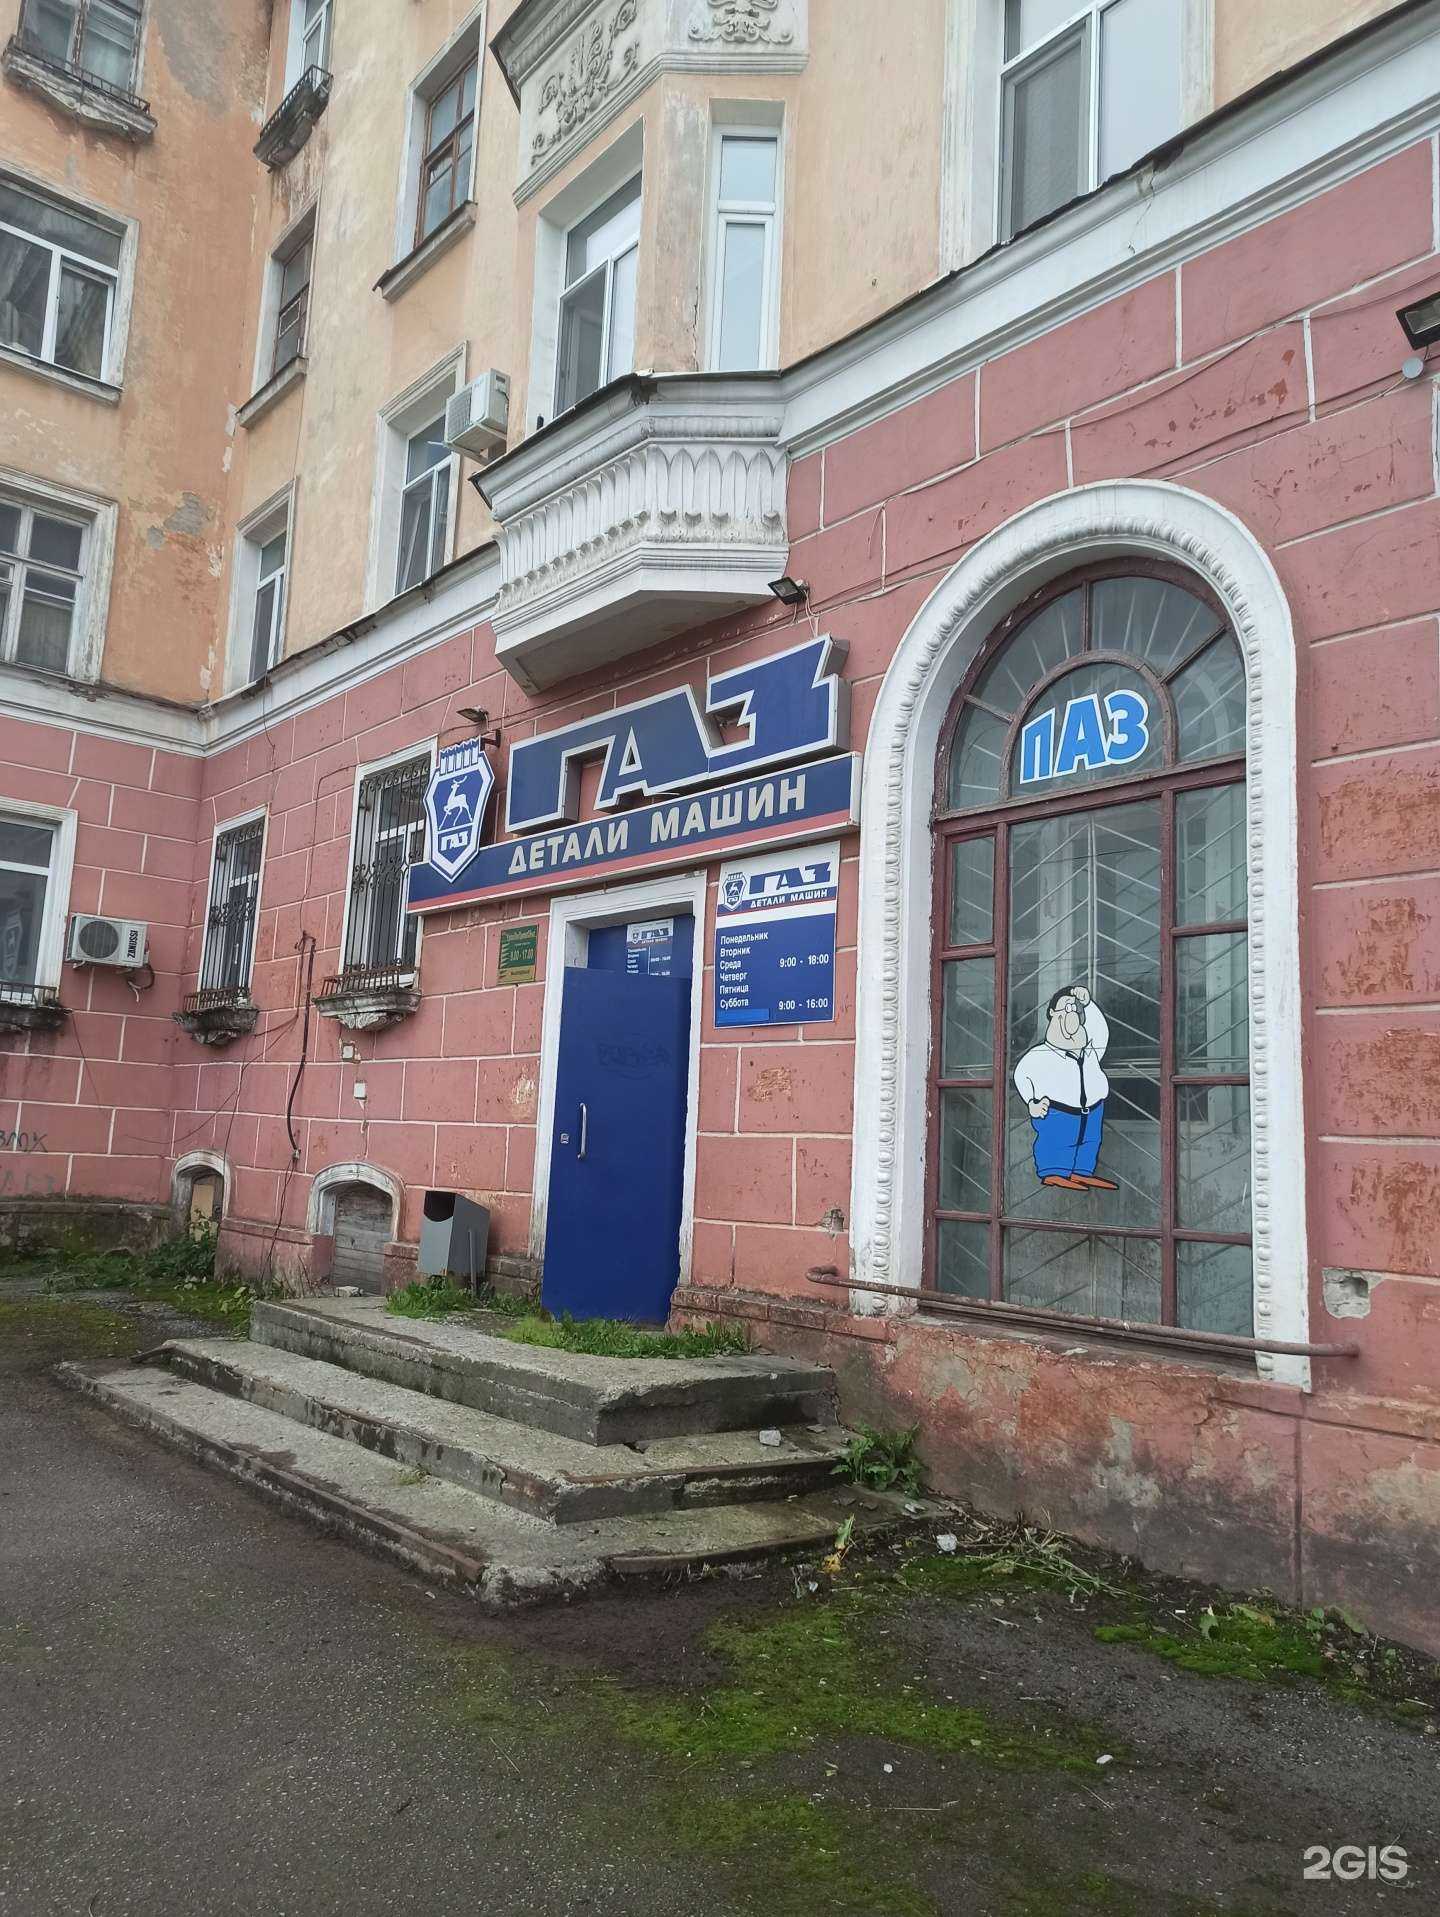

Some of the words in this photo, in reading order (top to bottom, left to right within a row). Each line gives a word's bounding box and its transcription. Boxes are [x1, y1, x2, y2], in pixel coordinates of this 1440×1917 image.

[505, 633, 848, 832] ГАЗ
[1020, 689, 1149, 784] ПАЗ
[508, 820, 629, 875] ДЕТАЛИ
[650, 774, 806, 844] МАШИН
[749, 862, 831, 894] ГАЗ
[750, 896, 786, 909] ДЕТАЛИ
[790, 888, 828, 902] МАШИН
[127, 930, 139, 958] ZANUSSI
[720, 931, 769, 945] Понедельник
[720, 946, 751, 958] Вторник
[719, 960, 742, 970] Среда
[779, 956, 797, 968] 9:00
[808, 953, 829, 965] 18:00
[719, 971, 748, 982] Четверг
[719, 984, 749, 995] Пятница
[720, 997, 749, 1010] Суббота
[778, 1000, 796, 1011] 9:00
[806, 997, 829, 1009] 16:00
